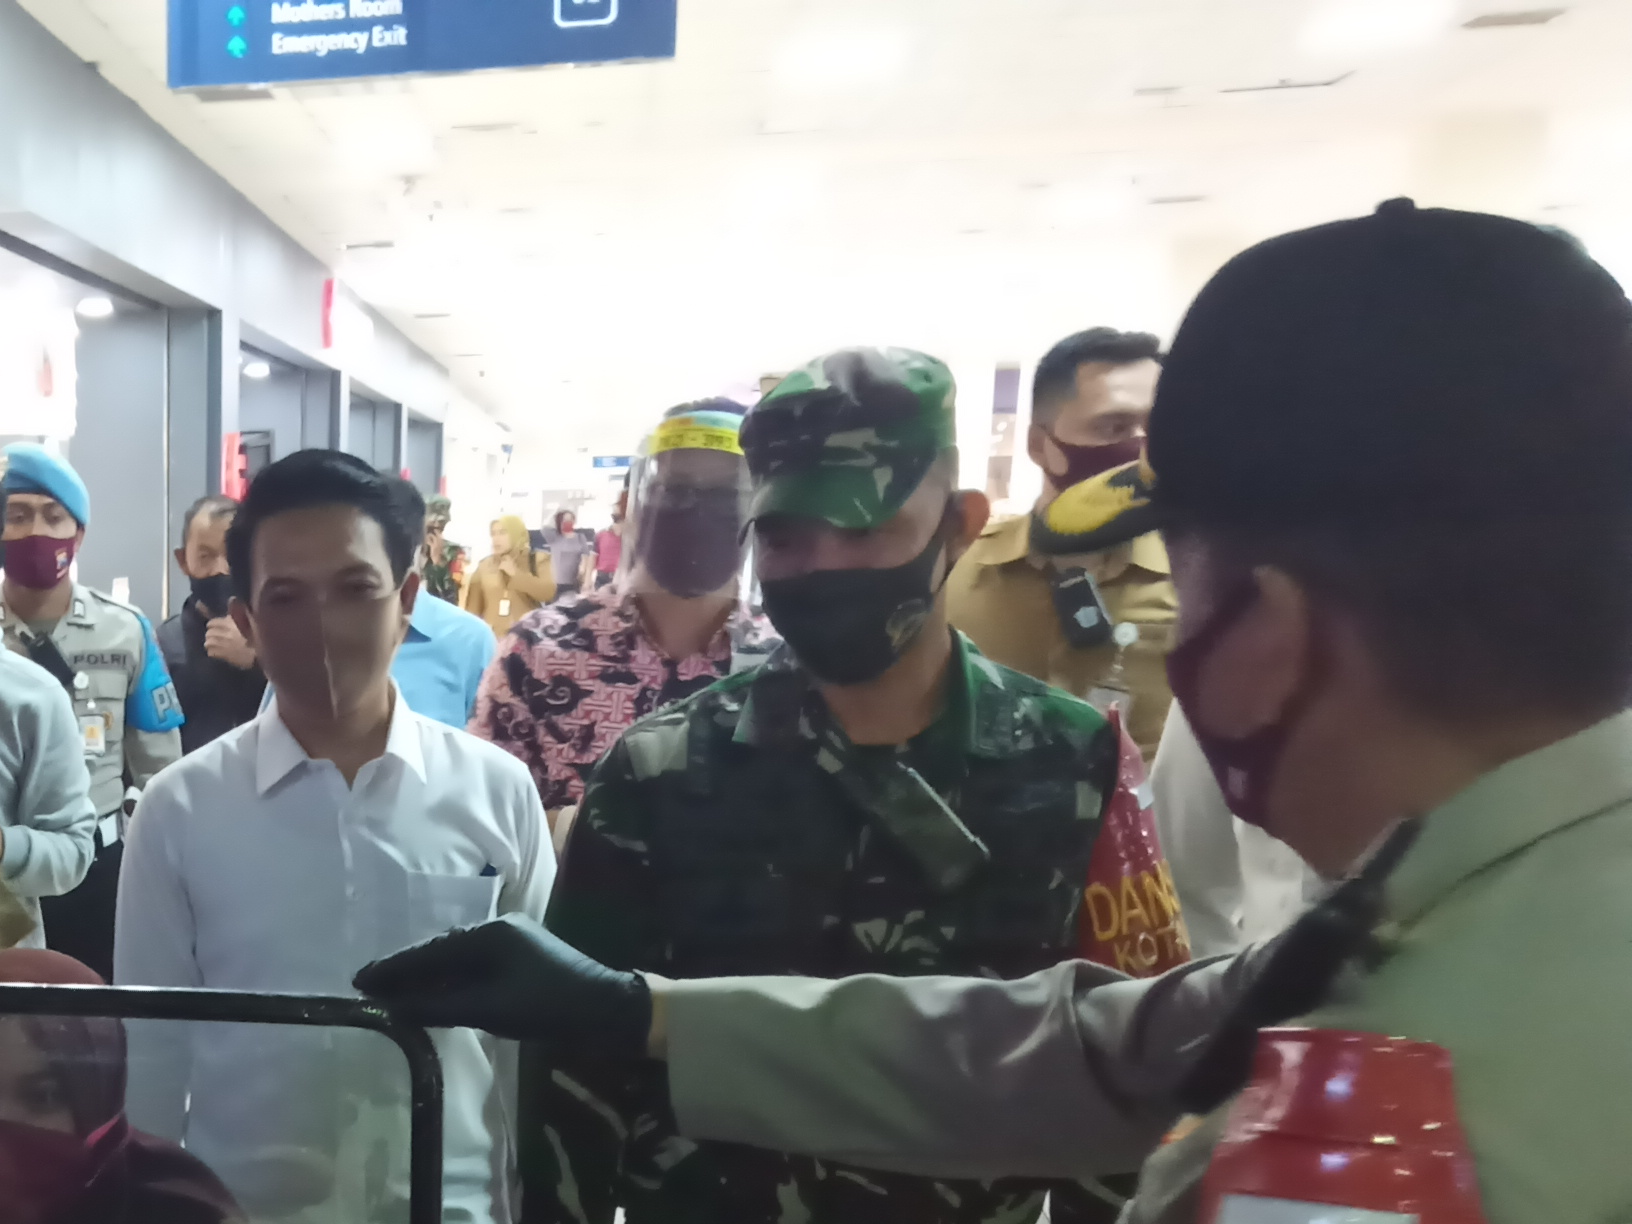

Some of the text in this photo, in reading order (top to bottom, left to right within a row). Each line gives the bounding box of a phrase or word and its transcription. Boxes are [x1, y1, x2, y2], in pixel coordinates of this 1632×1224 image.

[271, 24, 407, 57] Emergency Exit
[73, 653, 127, 665] POLRI
